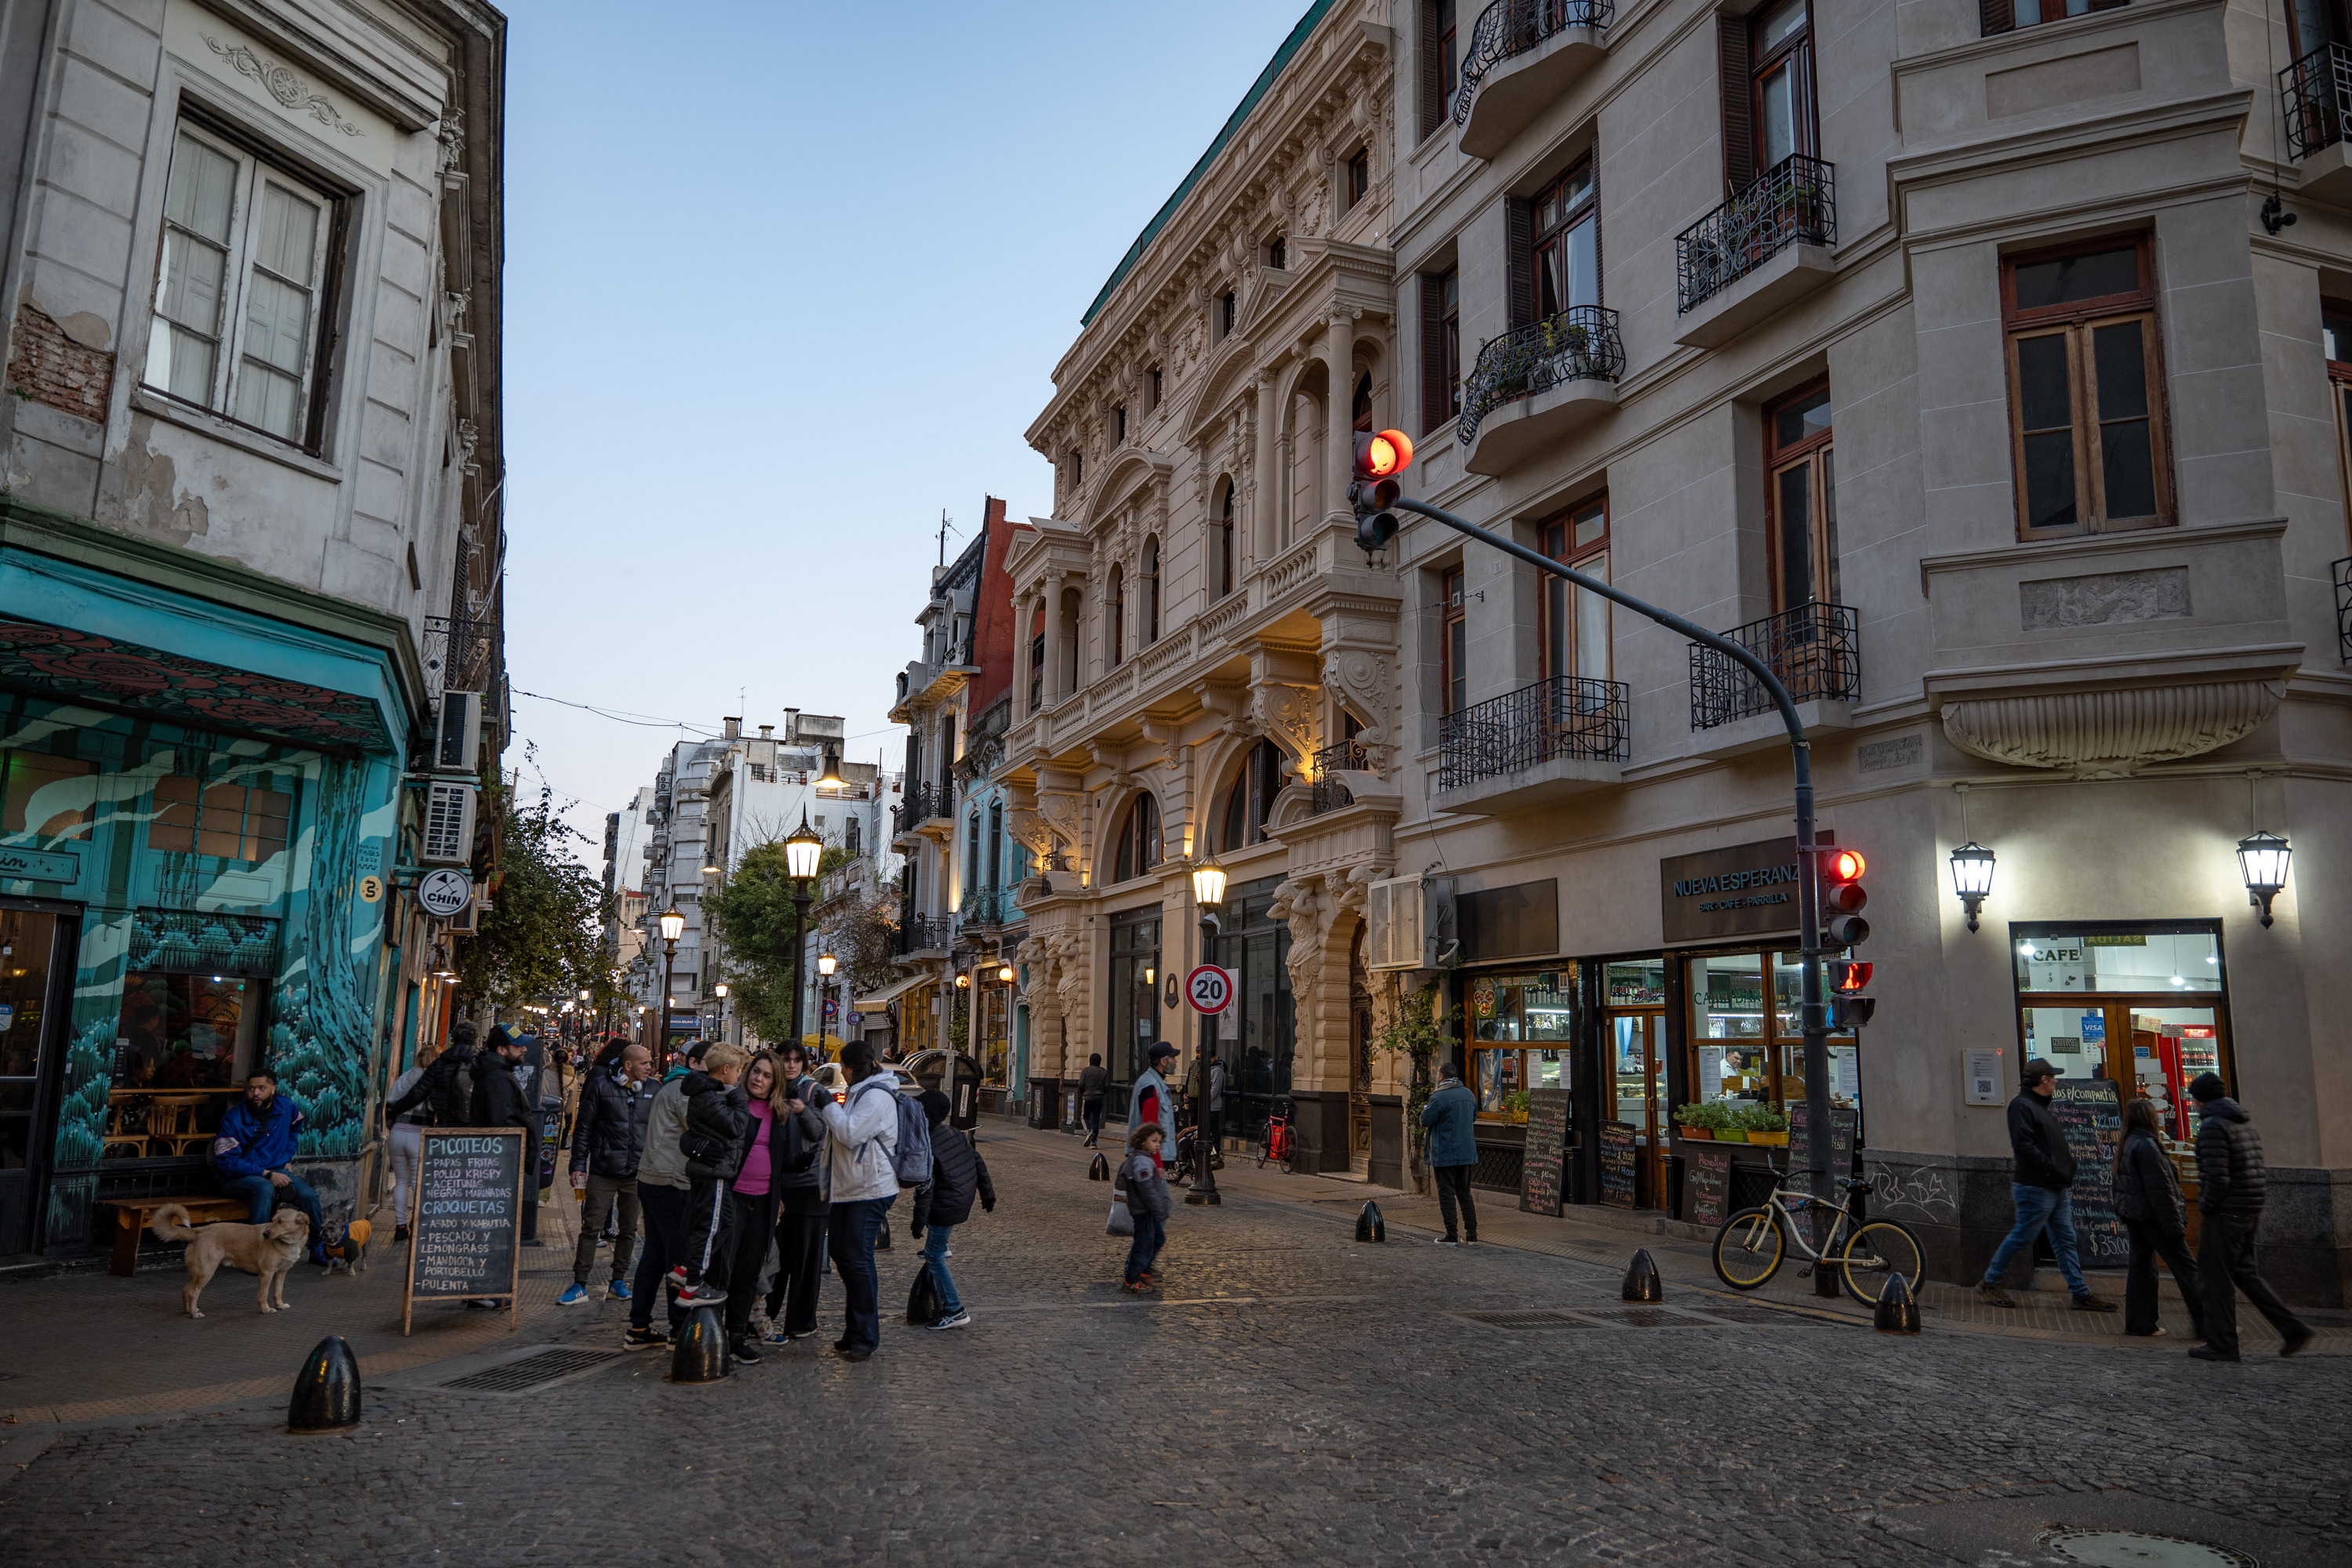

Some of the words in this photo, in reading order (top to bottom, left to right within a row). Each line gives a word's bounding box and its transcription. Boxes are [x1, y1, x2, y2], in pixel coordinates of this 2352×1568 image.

[1674, 876, 1719, 897] NUEVA
[1721, 862, 1799, 891] ESPERANZ
[427, 892, 462, 906] CHIN
[1698, 902, 1714, 912] BAR
[1719, 898, 1740, 910] CAFE
[1747, 892, 1788, 907] PARRILLA
[2033, 949, 2079, 961] CAFE
[1196, 979, 1222, 1000] 20
[2053, 1038, 2078, 1047] NUEVA
[428, 1137, 503, 1155] PICOTEOS
[434, 1158, 461, 1167] PAPAS
[468, 1157, 499, 1167] FRITAS
[434, 1169, 461, 1179] POLLO
[466, 1168, 502, 1179] KRISPY
[433, 1179, 484, 1189] ACEITUNAS
[426, 1188, 463, 1198] NEGRAS
[465, 1187, 512, 1198] MARINADAS
[422, 1200, 506, 1214] CROQUETAS
[430, 1219, 457, 1229] ASADO
[462, 1219, 468, 1228] Y
[470, 1218, 510, 1229] KABUTIA
[429, 1231, 476, 1243] PESCADO
[484, 1231, 491, 1242] Y
[421, 1243, 489, 1254] LEMONGRASS
[426, 1255, 474, 1267] MANDIOCA
[480, 1258, 487, 1268] Y
[424, 1266, 485, 1276] PORTOBELLO
[422, 1279, 469, 1290] PULENTA
